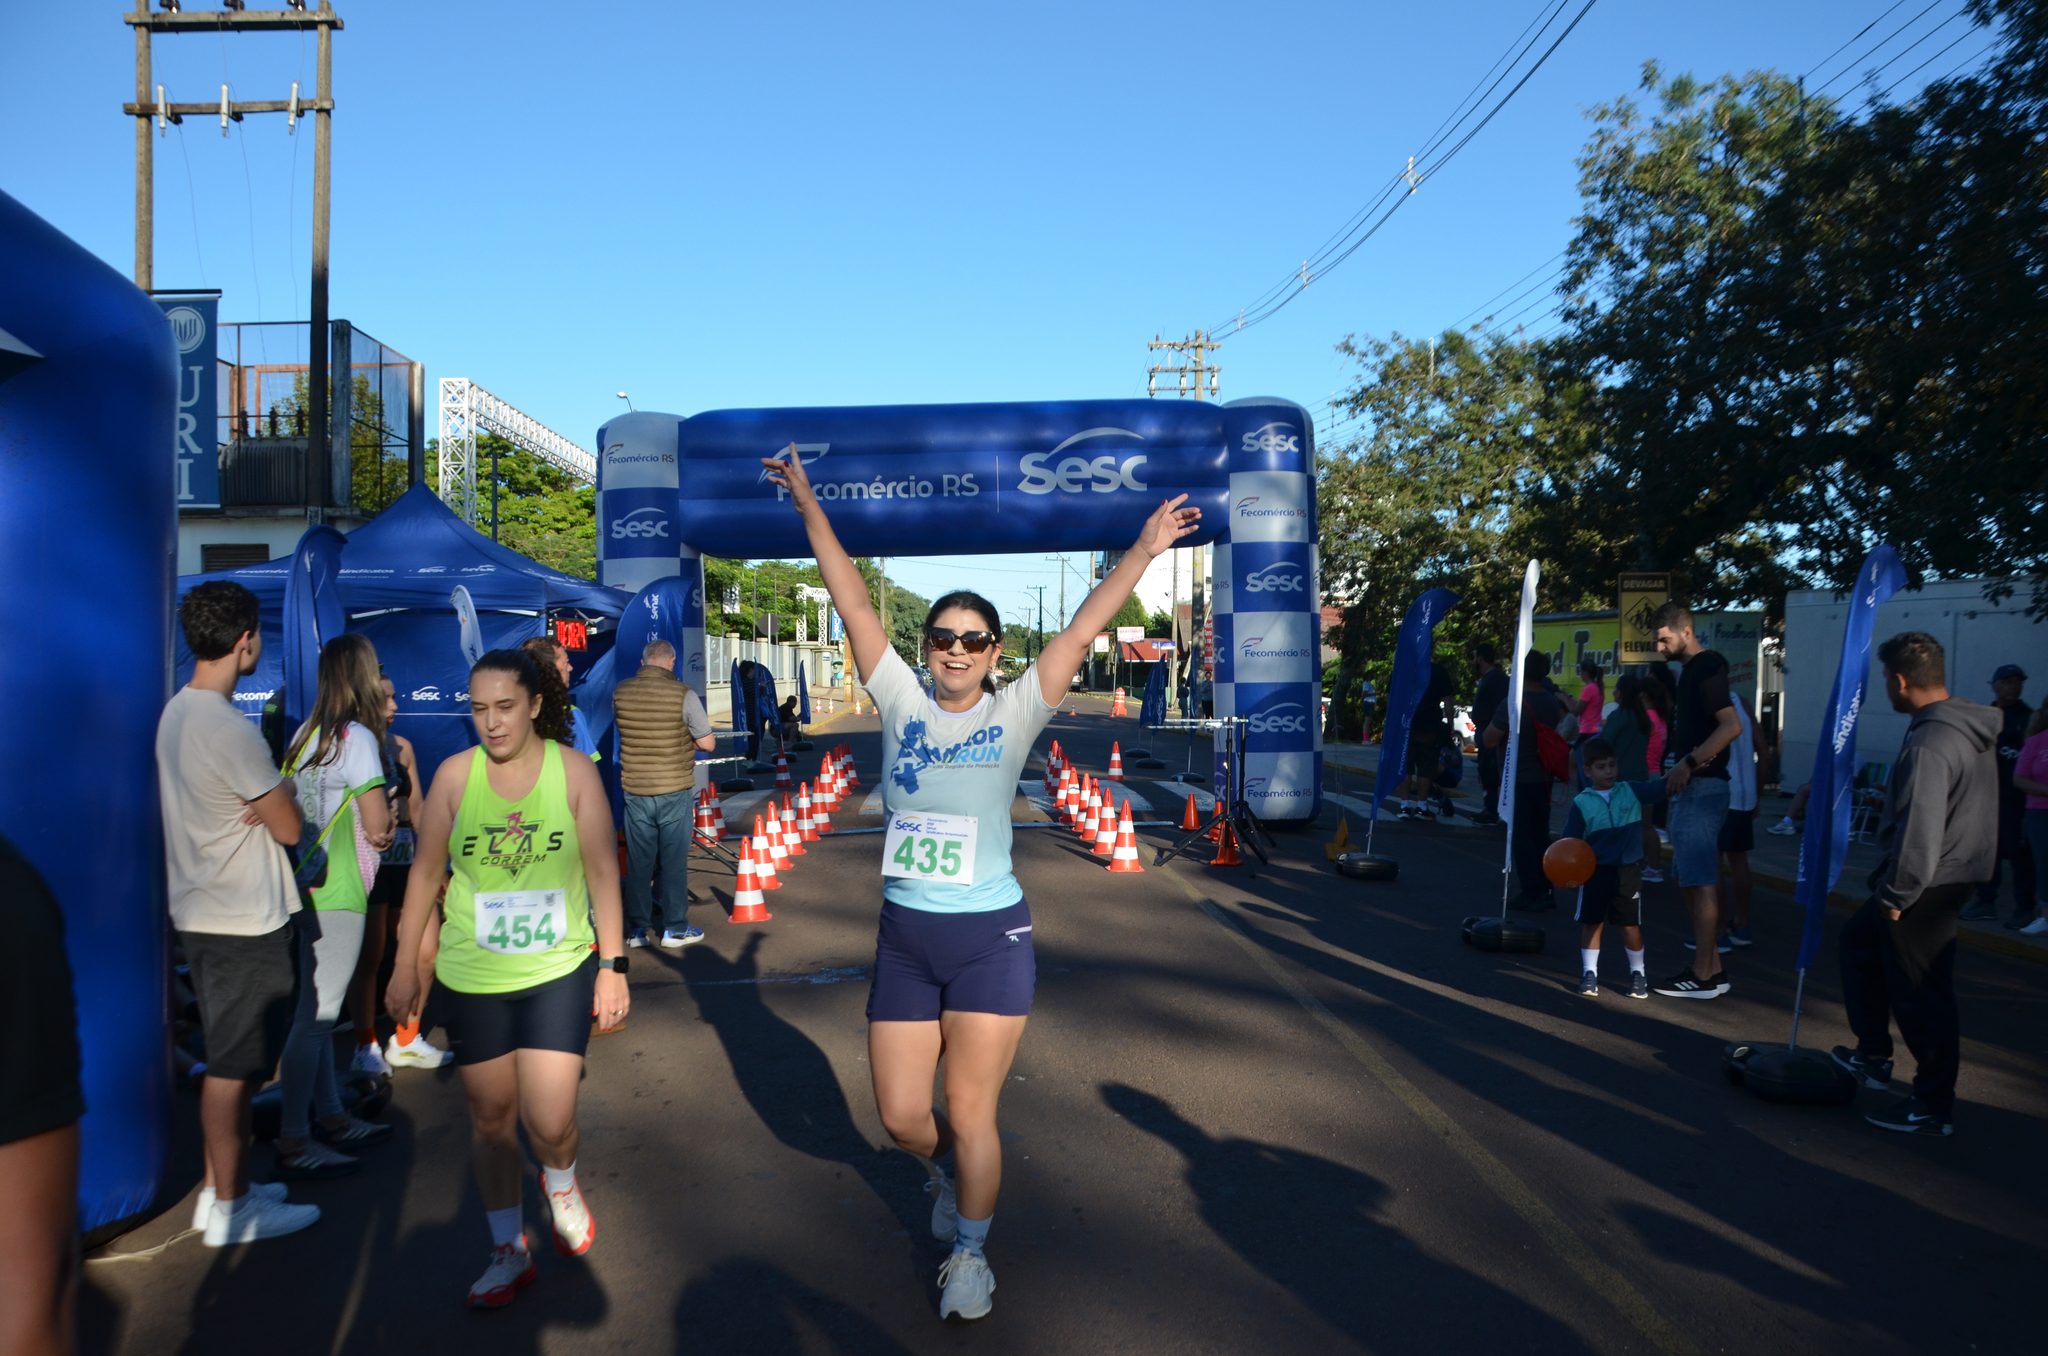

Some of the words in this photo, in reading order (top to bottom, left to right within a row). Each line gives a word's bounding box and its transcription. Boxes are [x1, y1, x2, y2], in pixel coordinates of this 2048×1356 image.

[1242, 428, 1299, 453] Sesc
[608, 454, 659, 465] Fecomércio
[662, 454, 675, 463] RS
[1017, 438, 1148, 495] Sesc
[776, 475, 934, 502] Fcomércio
[942, 473, 979, 498] RS
[1241, 507, 1295, 518] Fecomércio
[1297, 509, 1307, 518] RS
[611, 513, 669, 539] Sesc
[1245, 567, 1303, 592] Sesc
[1623, 579, 1665, 589] DEVAGAR
[1244, 648, 1299, 658] Fecomércio
[1300, 649, 1310, 657] RS
[1624, 641, 1658, 653] ELEVA
[231, 689, 275, 701] Fecomé
[411, 688, 441, 701] Sesc
[1249, 708, 1306, 733] Sesc
[953, 745, 1003, 763] RUN
[1247, 787, 1301, 798] Fecomércio
[1303, 789, 1313, 797] RS
[895, 818, 922, 833] Sesc
[480, 854, 547, 866] CORREM
[893, 835, 963, 876] 435
[488, 912, 556, 949] 454
